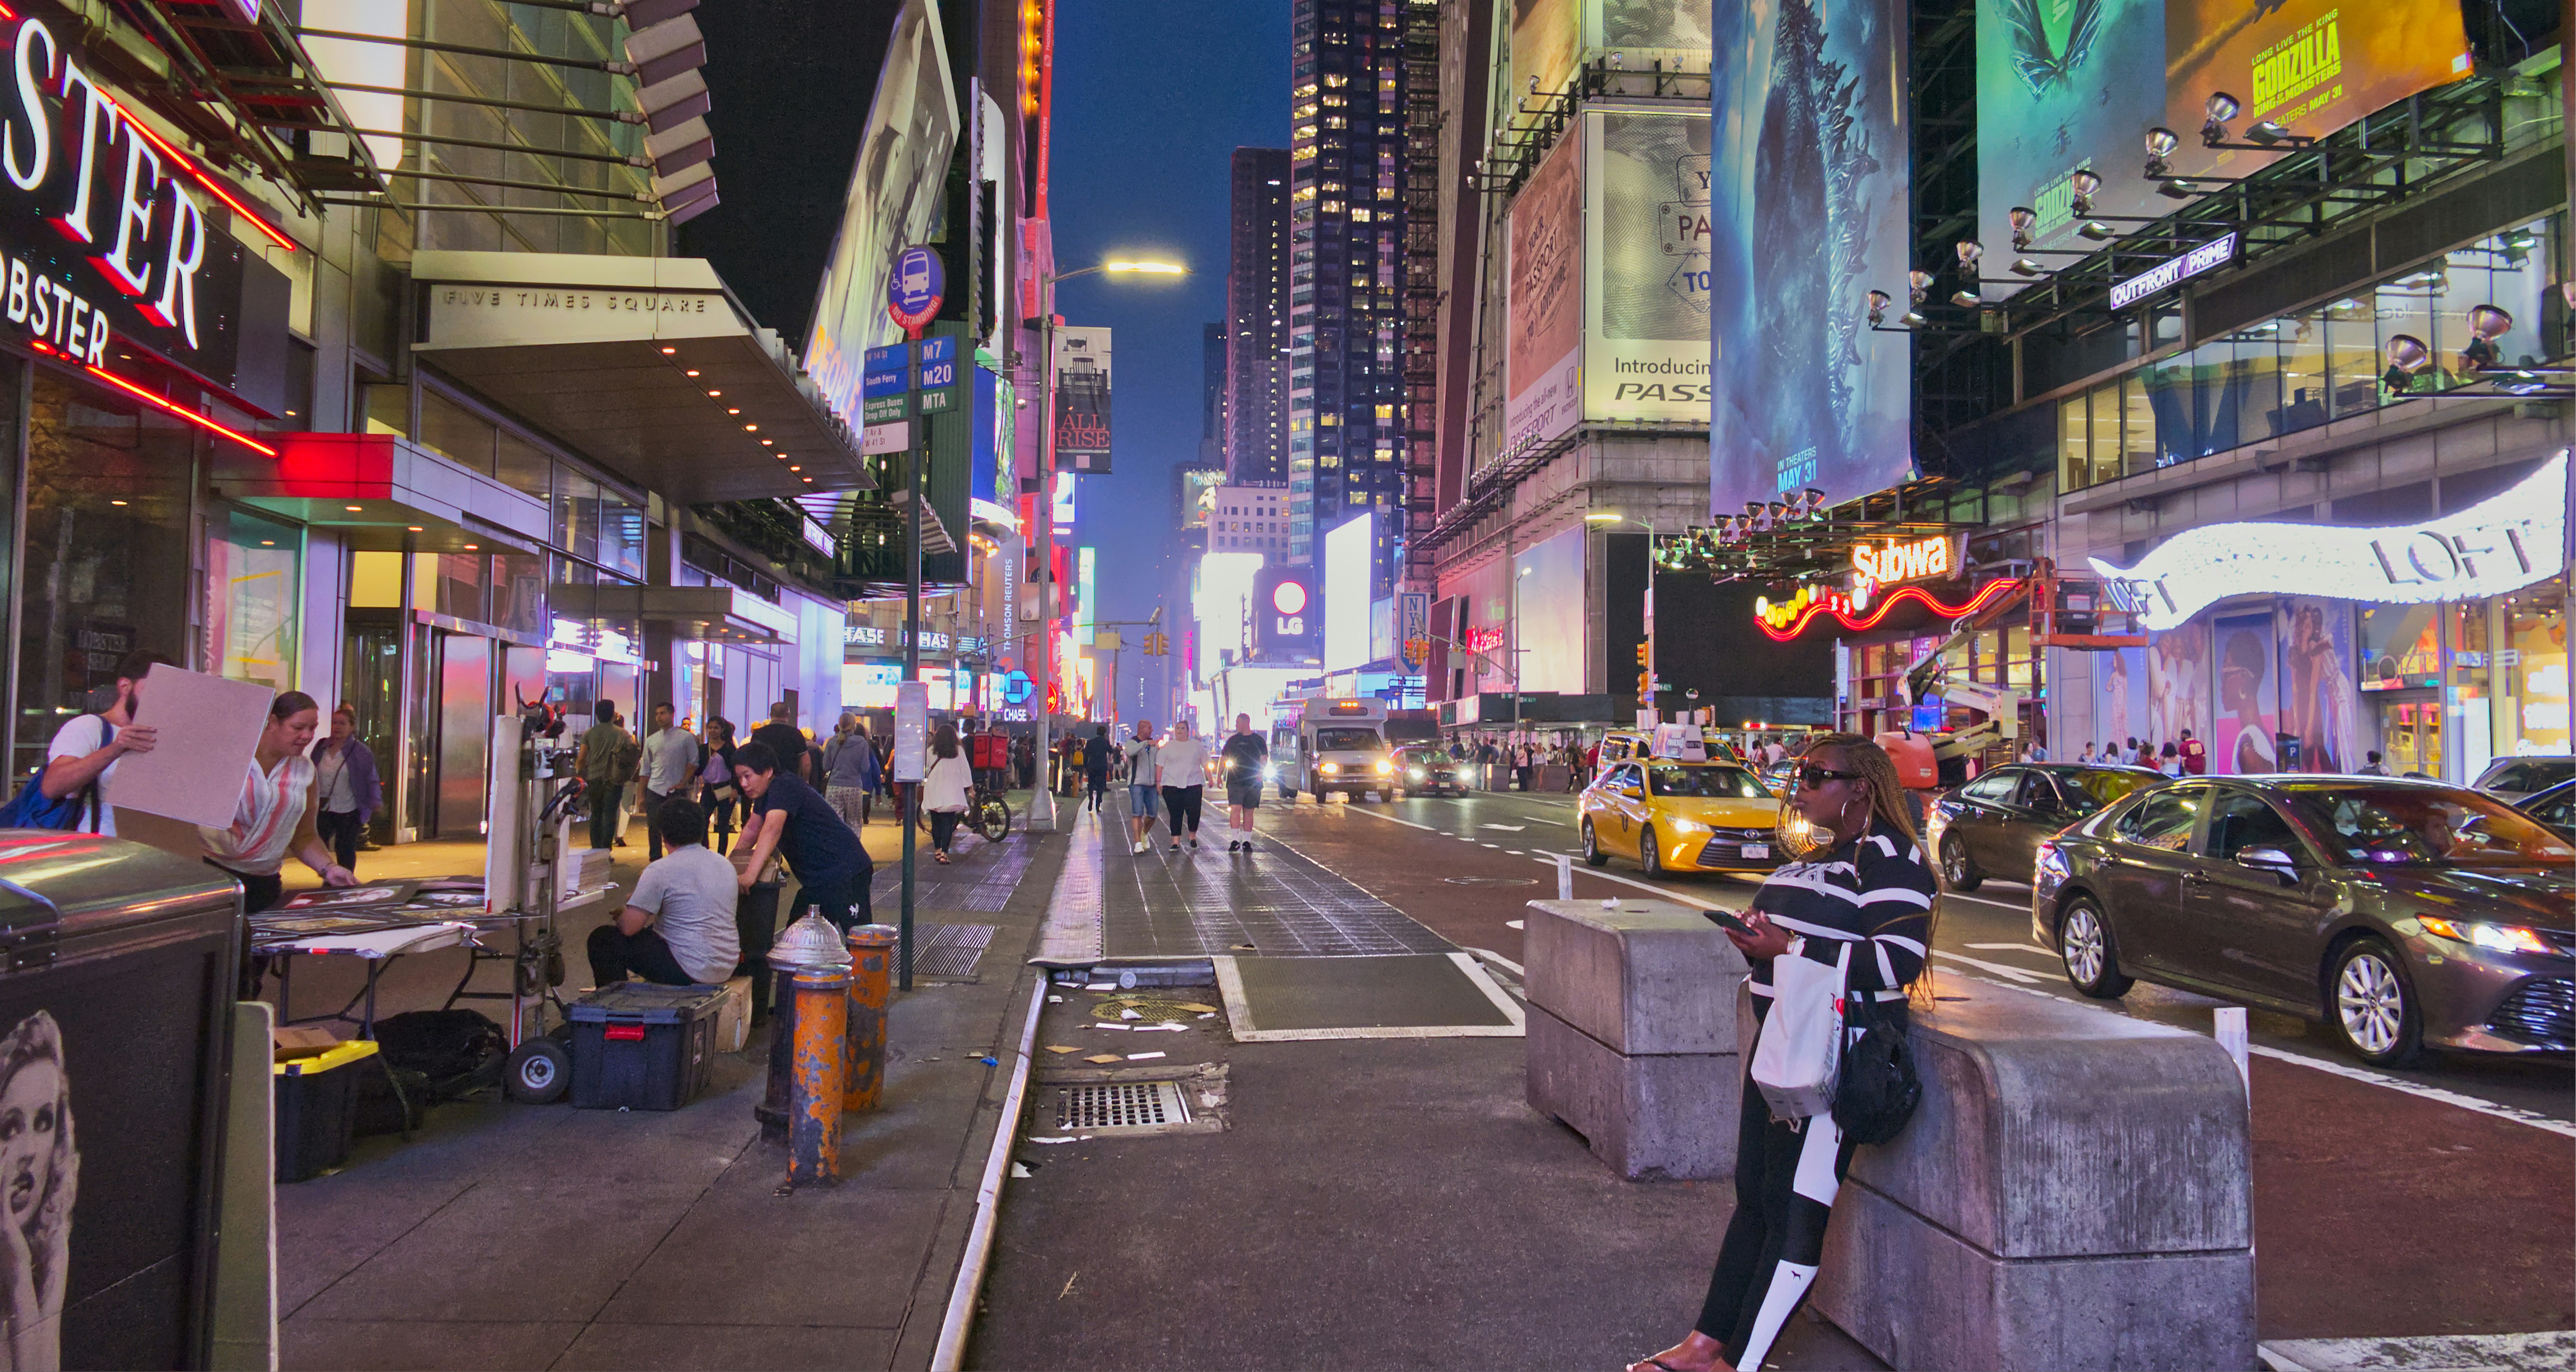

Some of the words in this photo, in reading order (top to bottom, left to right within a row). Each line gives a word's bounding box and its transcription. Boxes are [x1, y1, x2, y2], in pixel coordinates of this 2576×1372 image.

[2252, 46, 2274, 66] LONG
[2276, 35, 2294, 52] LIVE
[2297, 23, 2313, 39] THE
[2316, 8, 2338, 28] KING
[2253, 21, 2340, 105] GODZILLA
[2254, 97, 2277, 118] KING
[2286, 60, 2341, 102] MONSTERS
[2275, 103, 2307, 127] EATERS
[2309, 90, 2331, 111] MAY
[2332, 84, 2342, 99] 31
[3, 18, 198, 350] STER
[2034, 183, 2049, 197] LONG
[2050, 174, 2062, 187] LIVE
[2064, 166, 2075, 178] THE
[2077, 157, 2091, 170] KING
[2035, 173, 2083, 229] GODZI
[2035, 223, 2050, 239] KING
[1525, 228, 1558, 303] PASSPORT
[2113, 260, 2182, 306] OUTFRONT
[2188, 239, 2229, 272] PRIME
[444, 290, 501, 307] FIVE
[517, 293, 590, 308] TIMES
[607, 295, 706, 313] SQUARE
[1540, 260, 1566, 321] ADVENTURE
[892, 306, 903, 320] NO
[902, 299, 938, 325] STANDING
[1527, 321, 1534, 339] TO
[924, 341, 942, 360] M7
[807, 324, 862, 426] PEOPLE
[924, 364, 952, 385] M20
[1615, 357, 1711, 375] Introducin
[866, 375, 881, 386] South
[882, 374, 897, 385] Ferry
[865, 399, 886, 411] Express
[887, 397, 903, 408] Buses
[923, 392, 946, 410] MTA
[865, 411, 878, 421] Drop
[880, 409, 888, 418] Off
[889, 408, 901, 417] Only
[1060, 414, 1106, 430] ALL
[865, 429, 869, 437] 7
[870, 428, 877, 436] Av
[865, 439, 871, 448] W
[872, 438, 878, 447] 41
[880, 437, 885, 446] St
[1056, 430, 1110, 447] RISE
[1778, 459, 1784, 471] IN
[1786, 445, 1816, 468] THEATERS
[1778, 465, 1802, 493] MAY
[1805, 459, 1816, 482] 31
[1852, 536, 1947, 587] Subwa
[2370, 519, 2531, 586] LOFT
[1004, 558, 1013, 600] REUTERS
[1278, 617, 1303, 634] LG
[1409, 597, 1418, 640] NYP
[844, 627, 884, 644] HASE
[1004, 708, 1027, 722] CHASE
